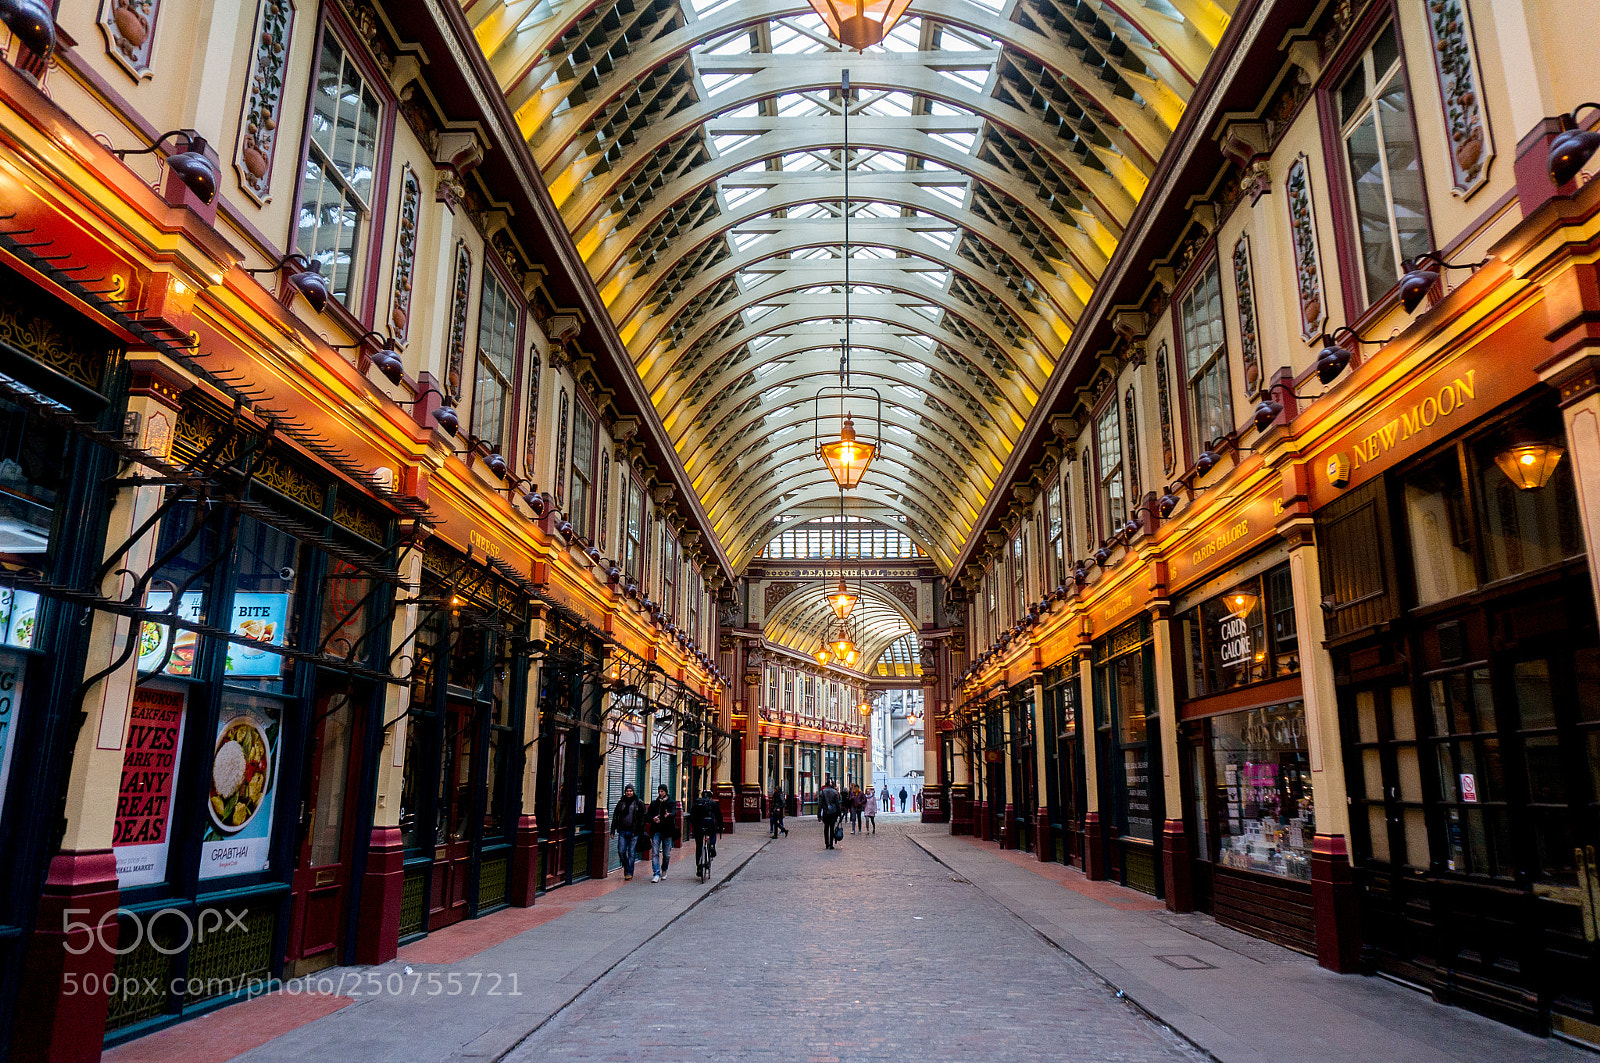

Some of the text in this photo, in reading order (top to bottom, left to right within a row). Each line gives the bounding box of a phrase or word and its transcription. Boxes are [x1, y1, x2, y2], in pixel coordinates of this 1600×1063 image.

[1352, 369, 1475, 470] NEW MOON
[470, 529, 500, 559] CHEESE
[1193, 519, 1249, 566] CARDS GALORE
[799, 569, 884, 577] LEADENHALL
[238, 606, 271, 617] BITE
[1221, 617, 1247, 641] CARDS
[1221, 636, 1251, 661] GALORE
[134, 690, 180, 707] ANGKOK
[131, 706, 179, 722] EAKFAST
[126, 725, 178, 751] IVES
[124, 751, 172, 768] ARK TO
[116, 795, 168, 817] REAT
[112, 819, 165, 843] DEAS
[211, 846, 249, 861] GRABTHAI
